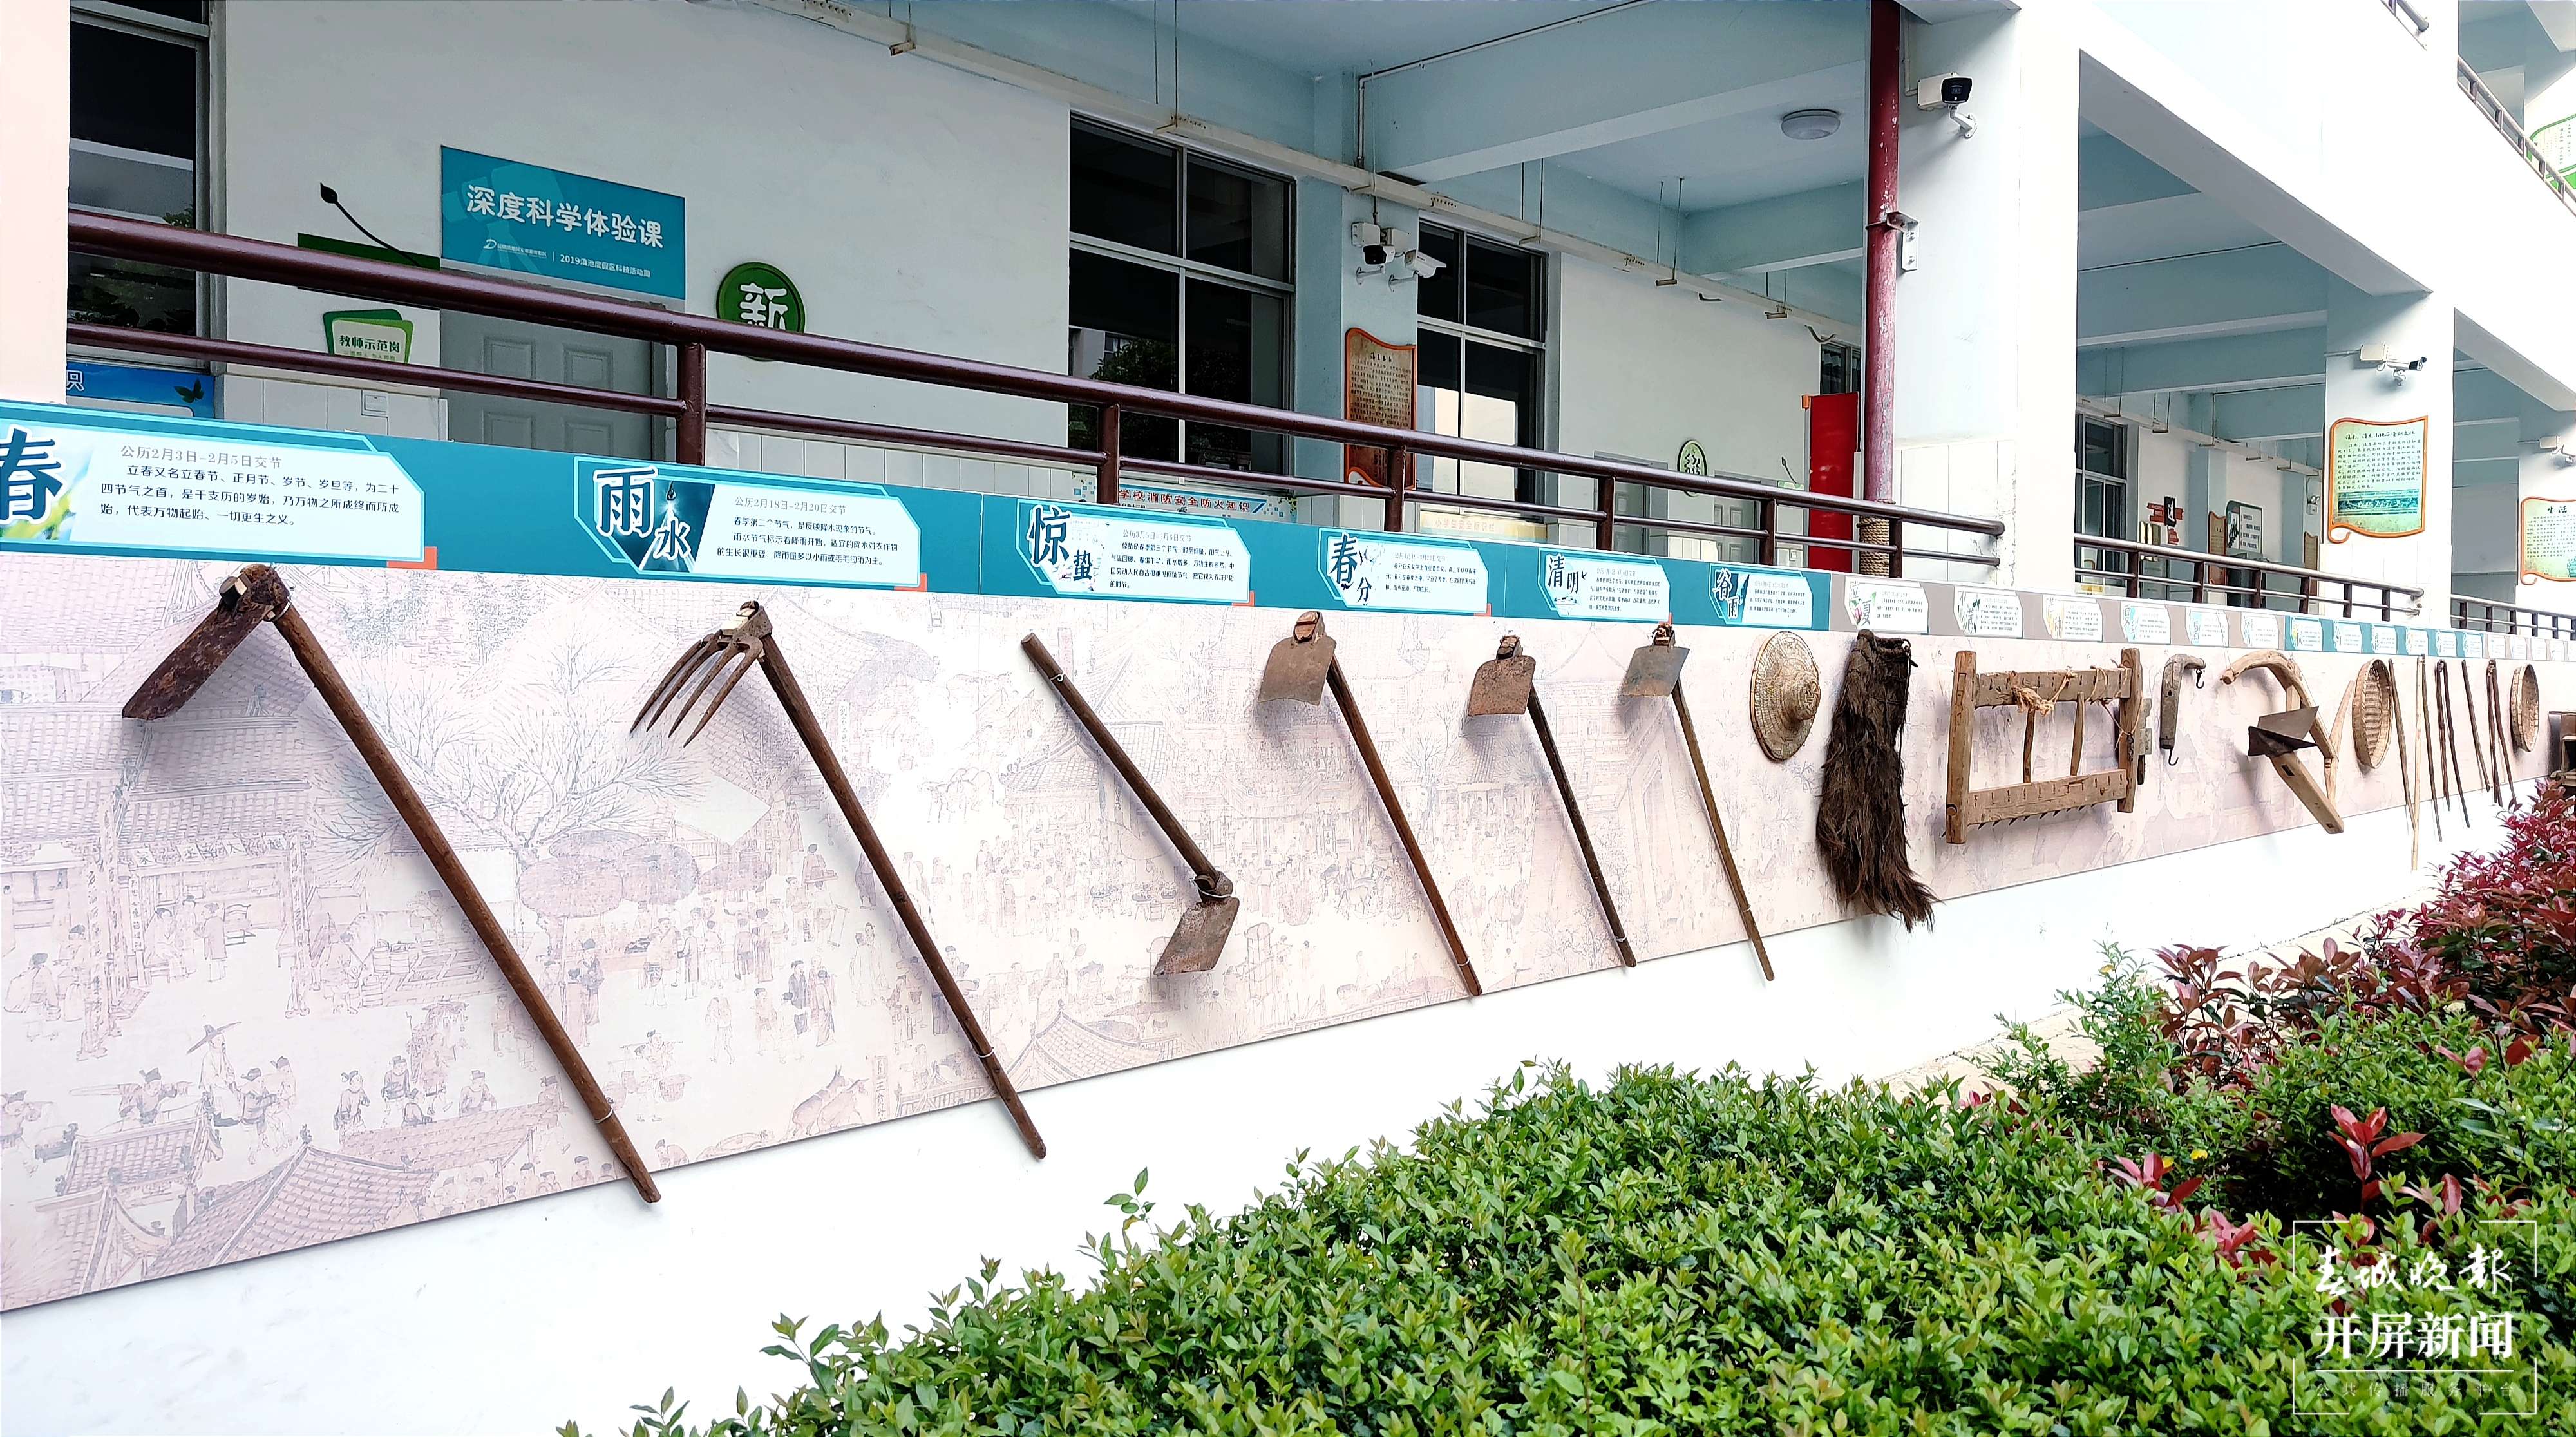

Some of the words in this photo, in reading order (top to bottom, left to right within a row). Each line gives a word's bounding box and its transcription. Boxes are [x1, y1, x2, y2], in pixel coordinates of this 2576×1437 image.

[465, 184, 665, 249] 深度科学体验课
[739, 282, 788, 330] 新
[339, 334, 400, 353] 教师示范岗
[120, 444, 282, 470] 公历2月3日-2月5日交节
[0, 427, 64, 517] 春
[735, 496, 846, 515] 公历2月18日-2月20日交节
[1119, 490, 1250, 512] 学校消防安全防火知识
